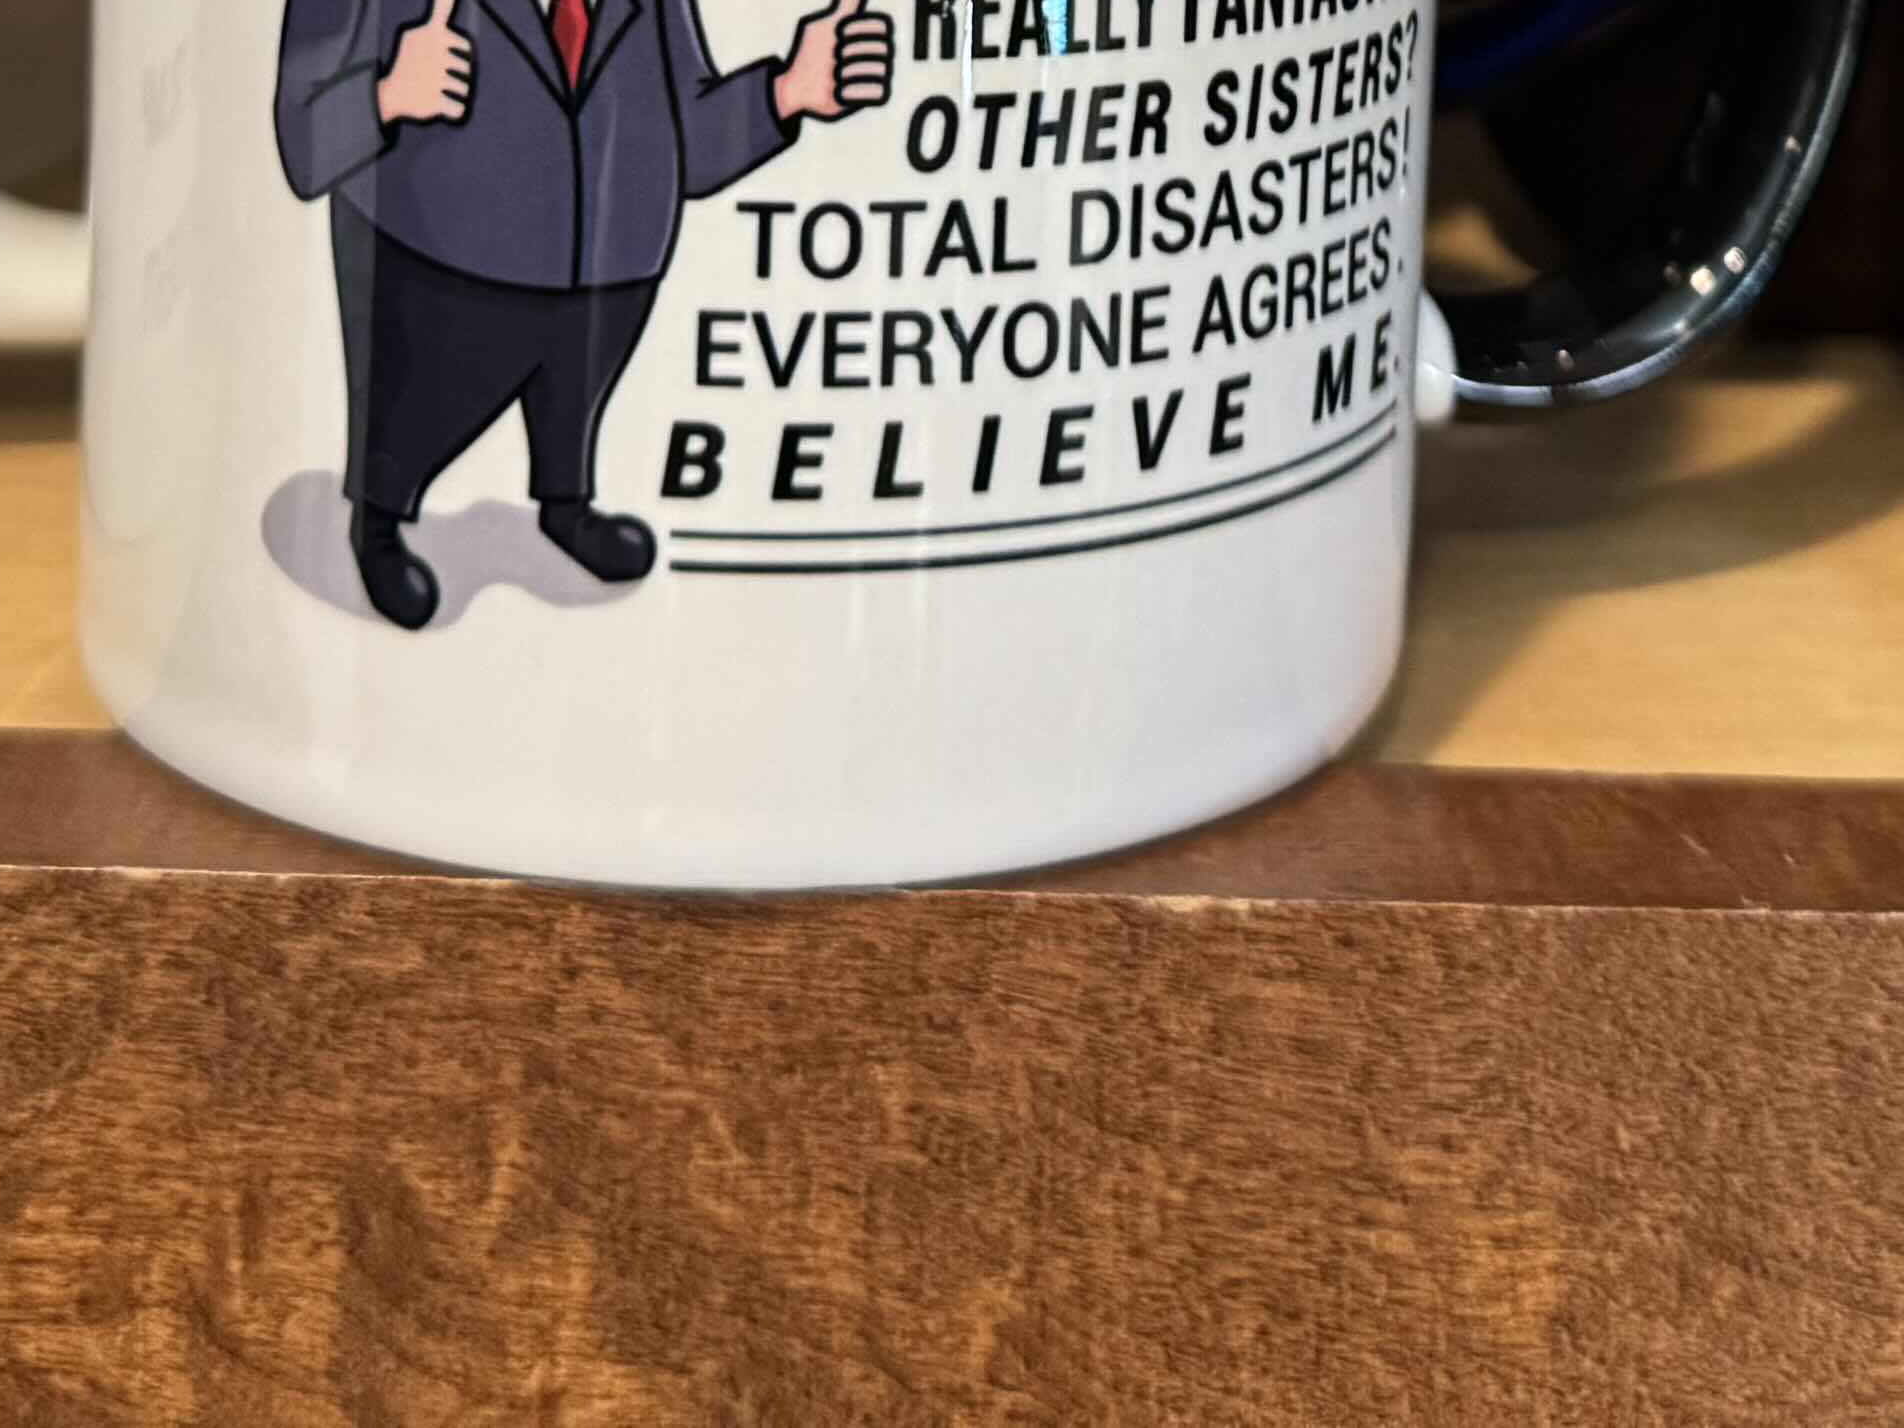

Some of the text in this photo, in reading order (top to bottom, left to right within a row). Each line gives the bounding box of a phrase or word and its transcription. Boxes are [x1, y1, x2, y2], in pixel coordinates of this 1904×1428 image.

[906, 10, 1418, 174] OTHER SISTERS?
[737, 108, 1412, 283] TOTAL DISASTERS!
[694, 221, 1404, 390] EVERYONE AGREES.
[662, 307, 1400, 502] BELIEVE ME.
